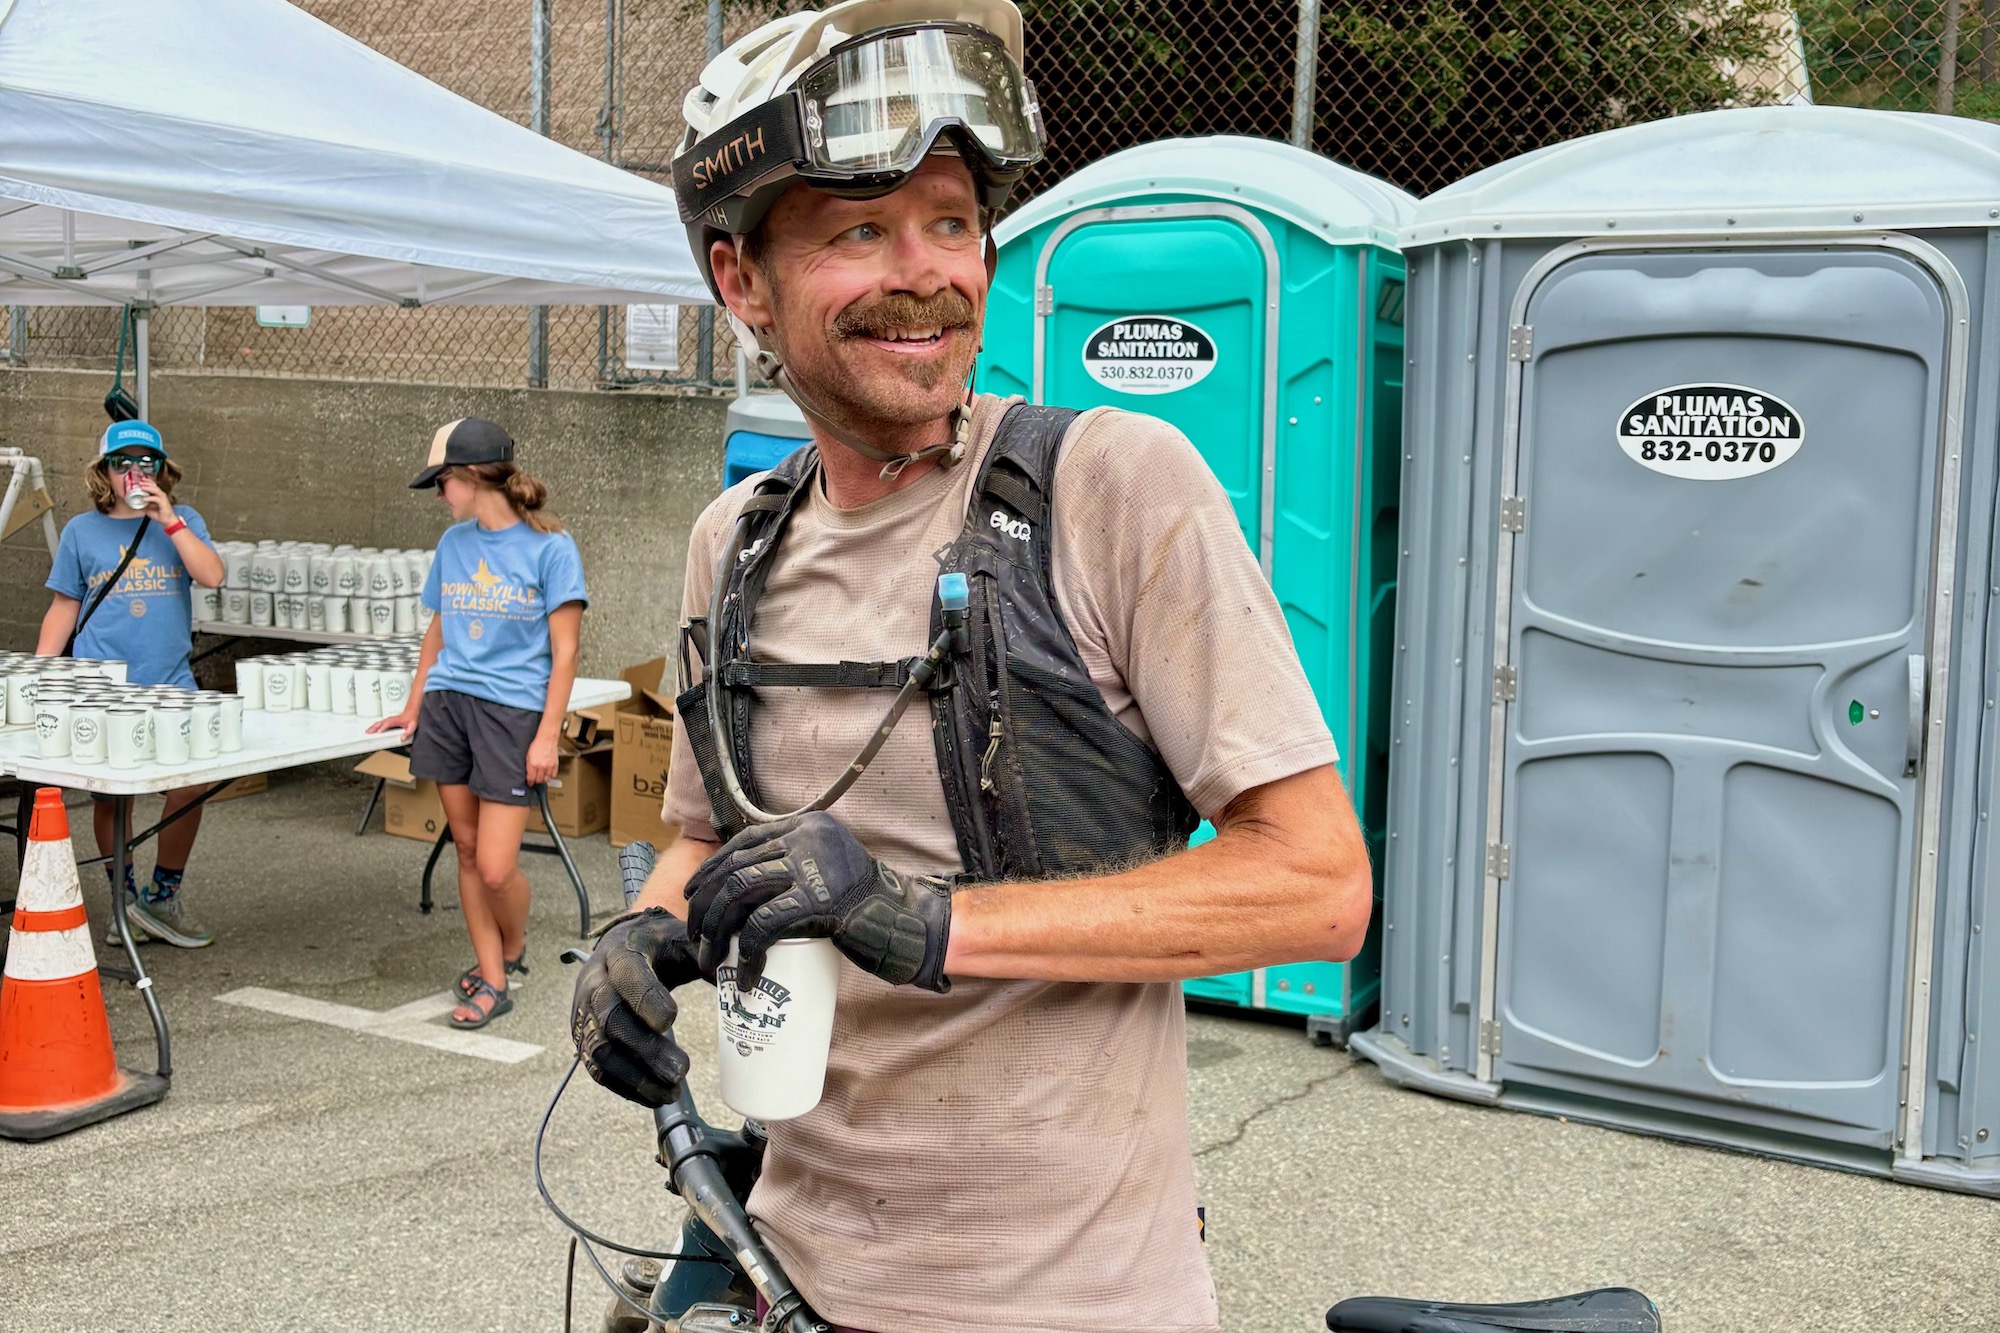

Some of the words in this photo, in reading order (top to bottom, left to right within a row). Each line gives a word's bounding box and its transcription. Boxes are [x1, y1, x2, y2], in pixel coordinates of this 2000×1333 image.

[692, 127, 766, 190] SMITH
[1113, 324, 1183, 340] PLUMAS
[1098, 342, 1199, 358] SANITATION
[1100, 366, 1194, 381] 530.832.0370
[1655, 395, 1765, 417] PLUMAS
[1629, 415, 1791, 438] SANITATION
[1641, 440, 1776, 463] 832-0370
[111, 578, 166, 594] LASSIC
[452, 596, 509, 613] CLASSIC
